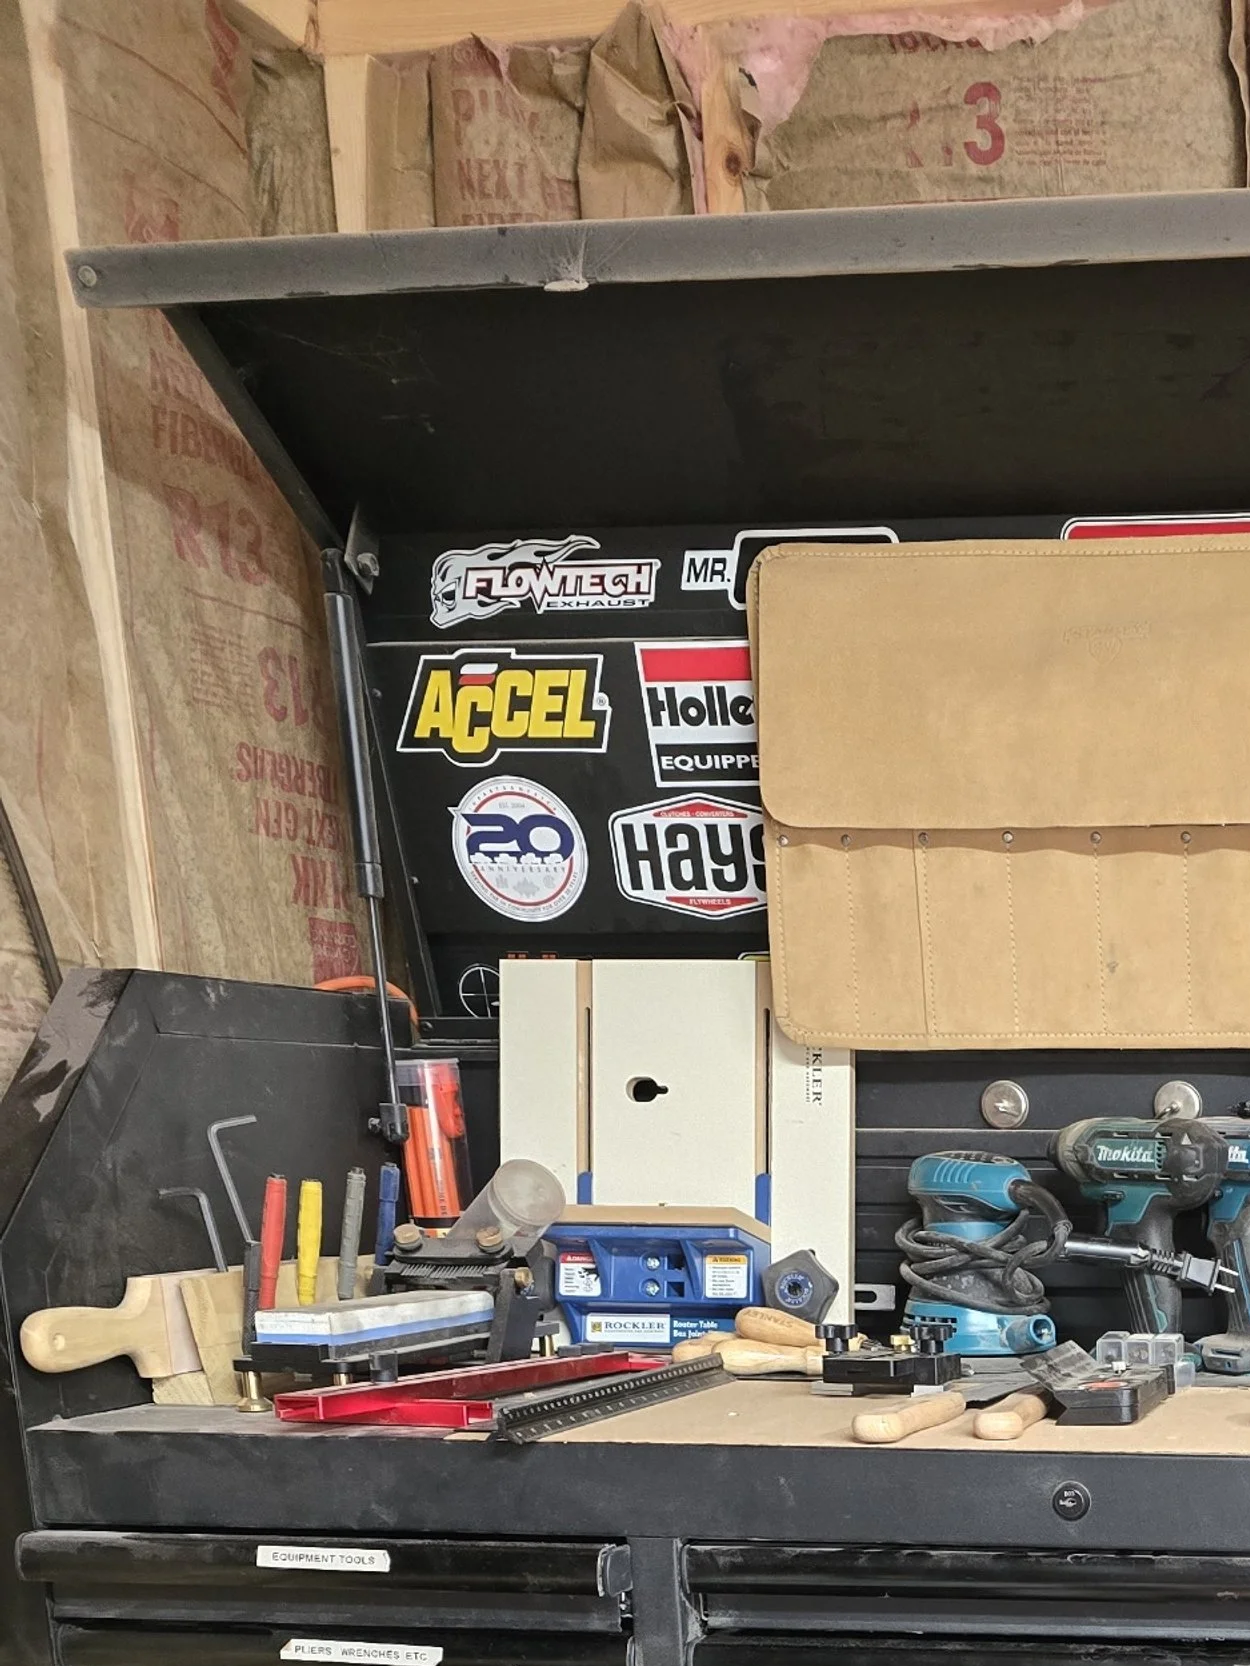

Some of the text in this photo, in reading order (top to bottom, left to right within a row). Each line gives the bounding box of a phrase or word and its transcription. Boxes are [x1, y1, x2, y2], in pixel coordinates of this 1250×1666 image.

[687, 556, 731, 584] MR.
[463, 559, 653, 605] FLOWTECH
[546, 598, 651, 610] EXHAUST
[414, 668, 597, 754] ACCEL
[1096, 1145, 1155, 1163] Makita
[605, 1321, 665, 1330] ROCKLER
[673, 1320, 719, 1329] Router Table
[743, 1309, 793, 1329] STANLEY
[272, 1552, 376, 1565] EQUIPMENT TOOLS
[294, 1645, 428, 1662] PLIERS WRENCHES ETC
